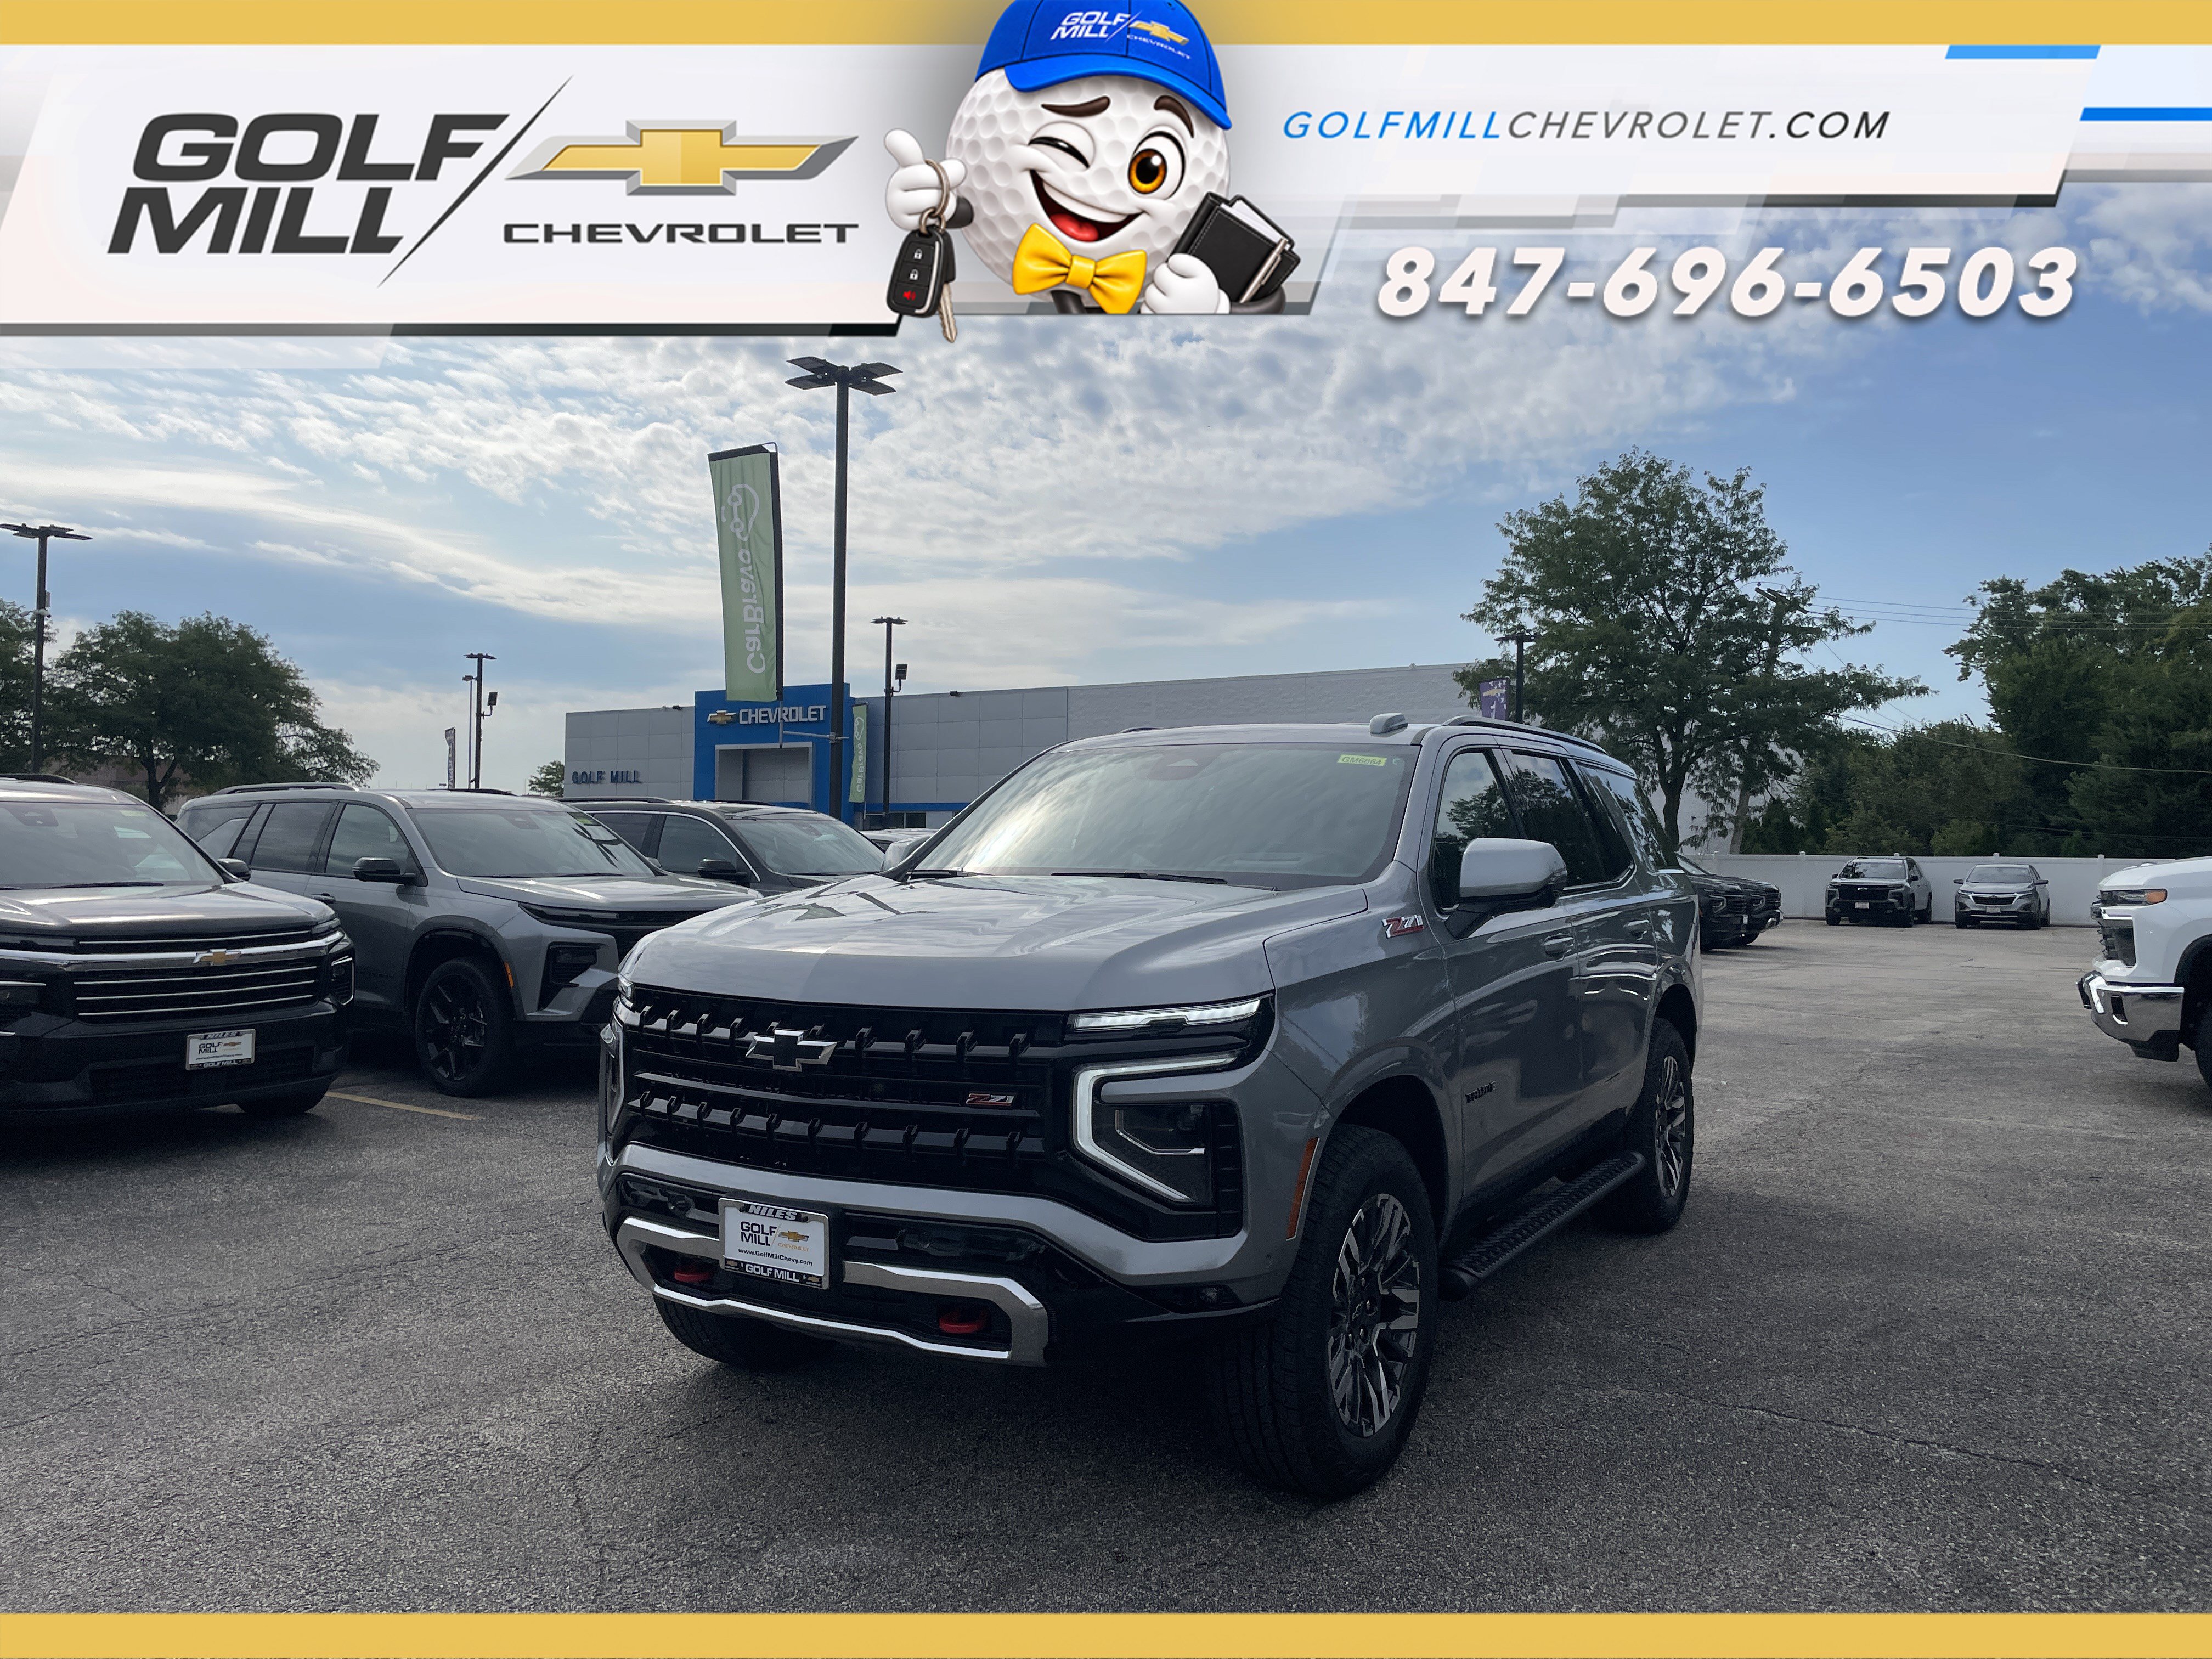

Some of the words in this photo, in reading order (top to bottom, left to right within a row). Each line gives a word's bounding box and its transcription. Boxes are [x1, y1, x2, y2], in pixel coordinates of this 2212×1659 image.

[739, 705, 827, 725] CHEVROLET
[572, 771, 604, 784] GOLF
[610, 770, 641, 783] MILL
[1381, 914, 1425, 938] Z71
[966, 1093, 1015, 1106] Z71
[748, 1205, 798, 1221] NILES
[740, 1221, 777, 1236] GOLF
[741, 1232, 771, 1246] MILL
[738, 1248, 813, 1266] www.GolfMillChevy.com
[745, 1263, 774, 1276] GOLF
[774, 1269, 800, 1283] MILL
